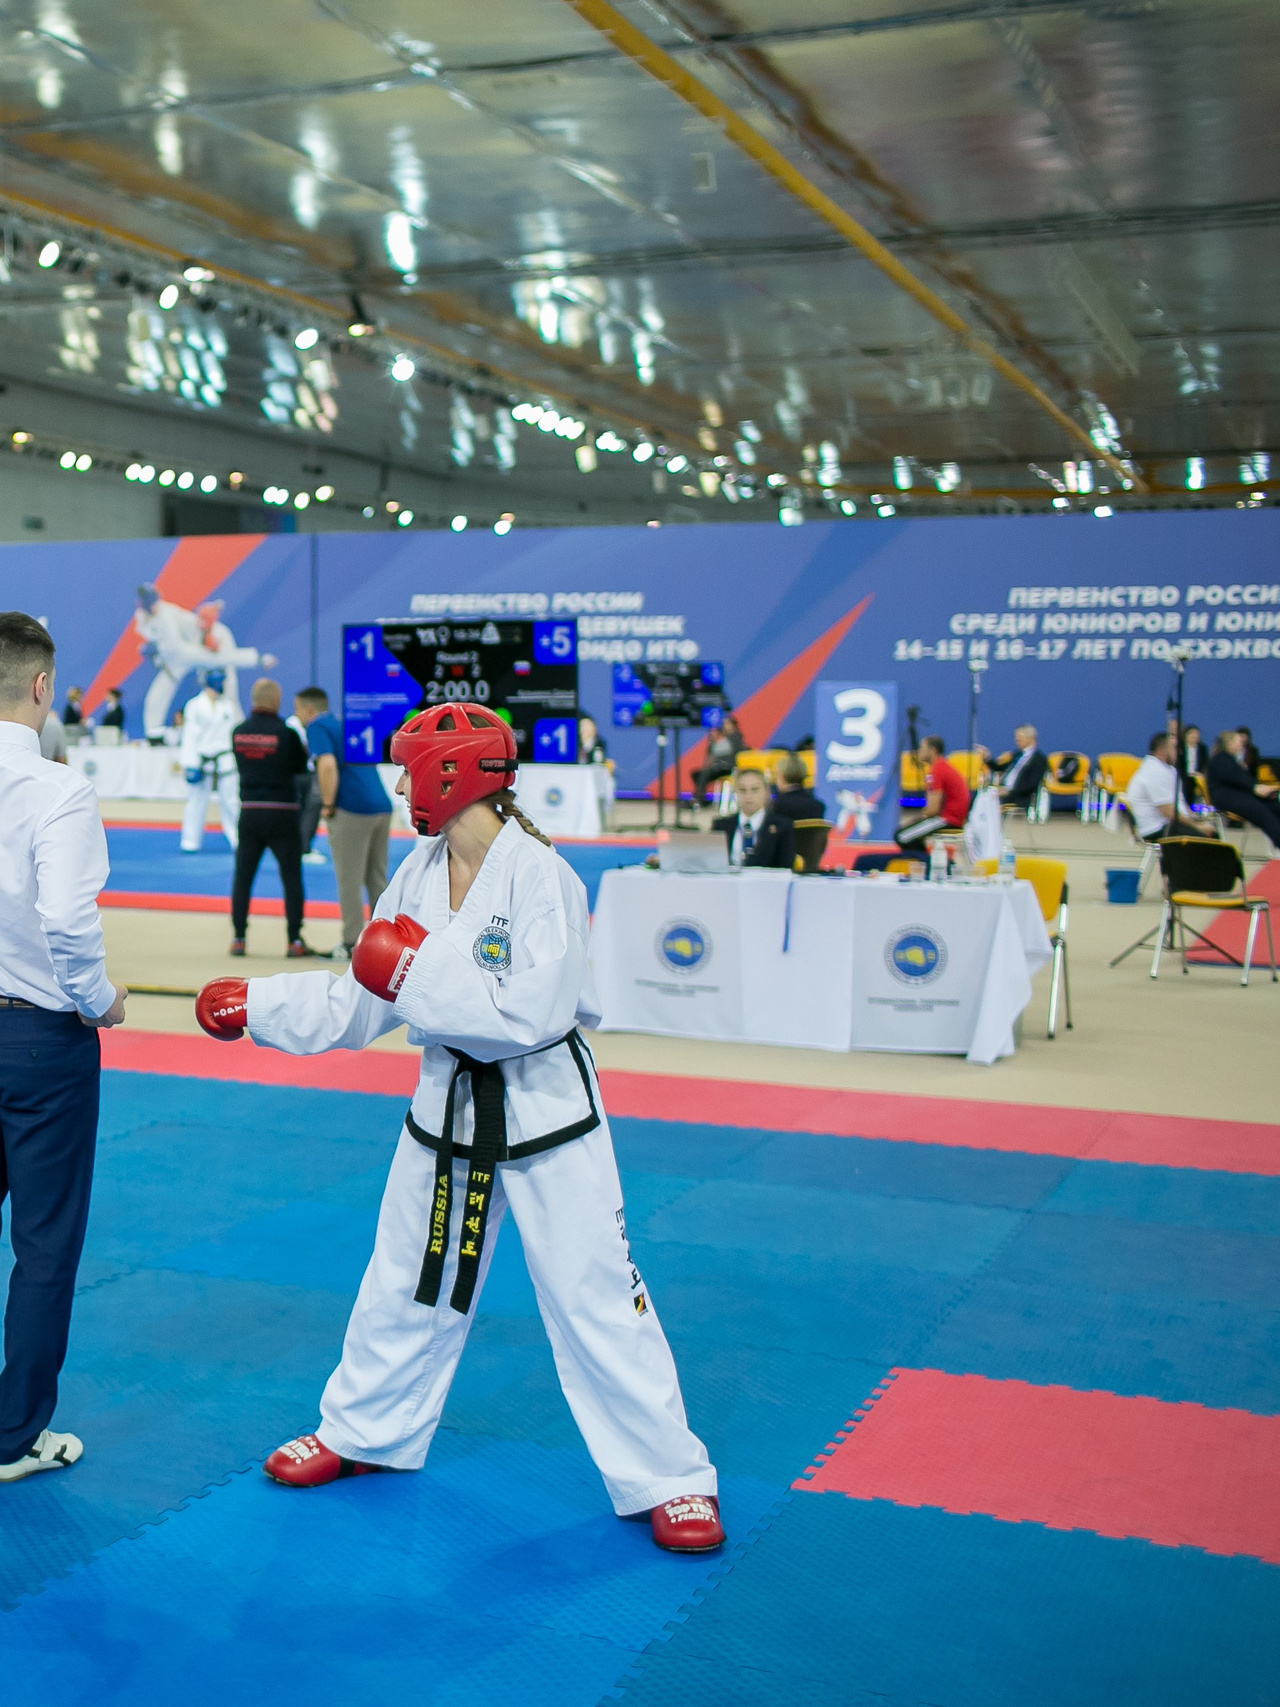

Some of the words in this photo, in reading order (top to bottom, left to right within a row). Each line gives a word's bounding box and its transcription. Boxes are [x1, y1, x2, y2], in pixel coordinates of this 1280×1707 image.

[410, 593, 548, 615] ПЕРВЕНСТВО
[552, 591, 644, 613] РОССИИ
[1008, 585, 1179, 609] ПЕРВЕНСТВО
[950, 612, 1037, 637] СРЕДИ
[1042, 611, 1182, 635] ЮНИОРОВ
[1186, 611, 1209, 633] И
[646, 638, 699, 662] ИТФ
[969, 638, 990, 660] И
[1073, 638, 1126, 661] ЛЕТ
[1130, 638, 1171, 660] ПО
[827, 688, 886, 764] 3
[491, 914, 509, 928] ITF
[472, 1170, 490, 1184] ITF
[430, 1174, 449, 1255] RUSSIA
[665, 1503, 690, 1518] TOP
